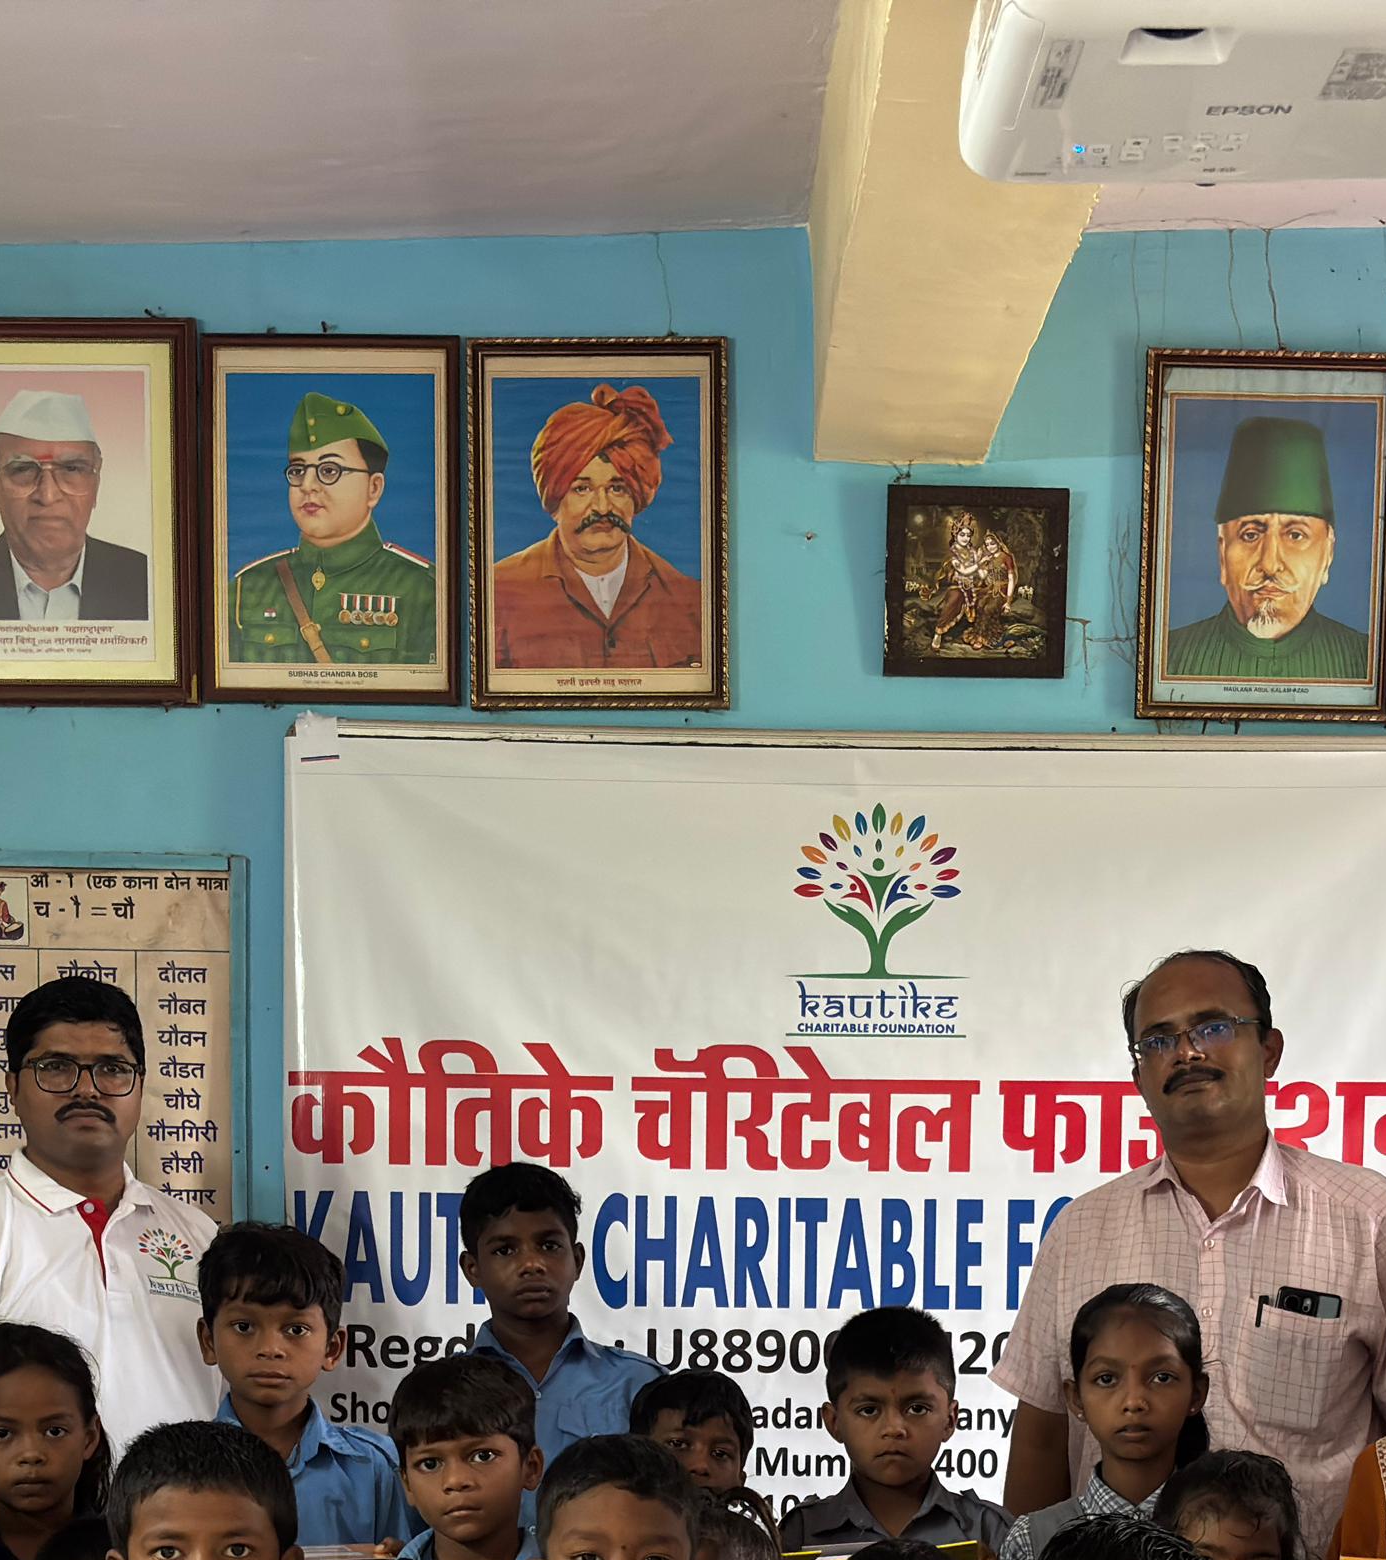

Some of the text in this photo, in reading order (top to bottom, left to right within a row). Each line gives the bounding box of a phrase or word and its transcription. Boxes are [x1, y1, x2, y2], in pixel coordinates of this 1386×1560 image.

[1205, 104, 1292, 117] EPSON
[122, 876, 158, 890] काना
[164, 872, 191, 891] दोन
[33, 901, 51, 918] च
[111, 896, 135, 919] चौ
[157, 960, 208, 985] दौलत
[158, 992, 206, 1016] नौबत
[796, 981, 959, 1019] kautike
[157, 1024, 207, 1048] यौवन
[797, 1022, 956, 1034] CHARITABLE FOUNDATION
[159, 1055, 205, 1079] दौडत
[163, 1088, 202, 1110] चौघे
[288, 1037, 614, 1168] कौतिके
[631, 1043, 981, 1173] चॅरिटेबल
[146, 1119, 218, 1143] मौनगिरी
[160, 1150, 204, 1174] हौशी
[592, 1192, 984, 1311] CHARITABLE
[330, 1391, 390, 1425] Sho
[755, 1446, 847, 1478] Mum
